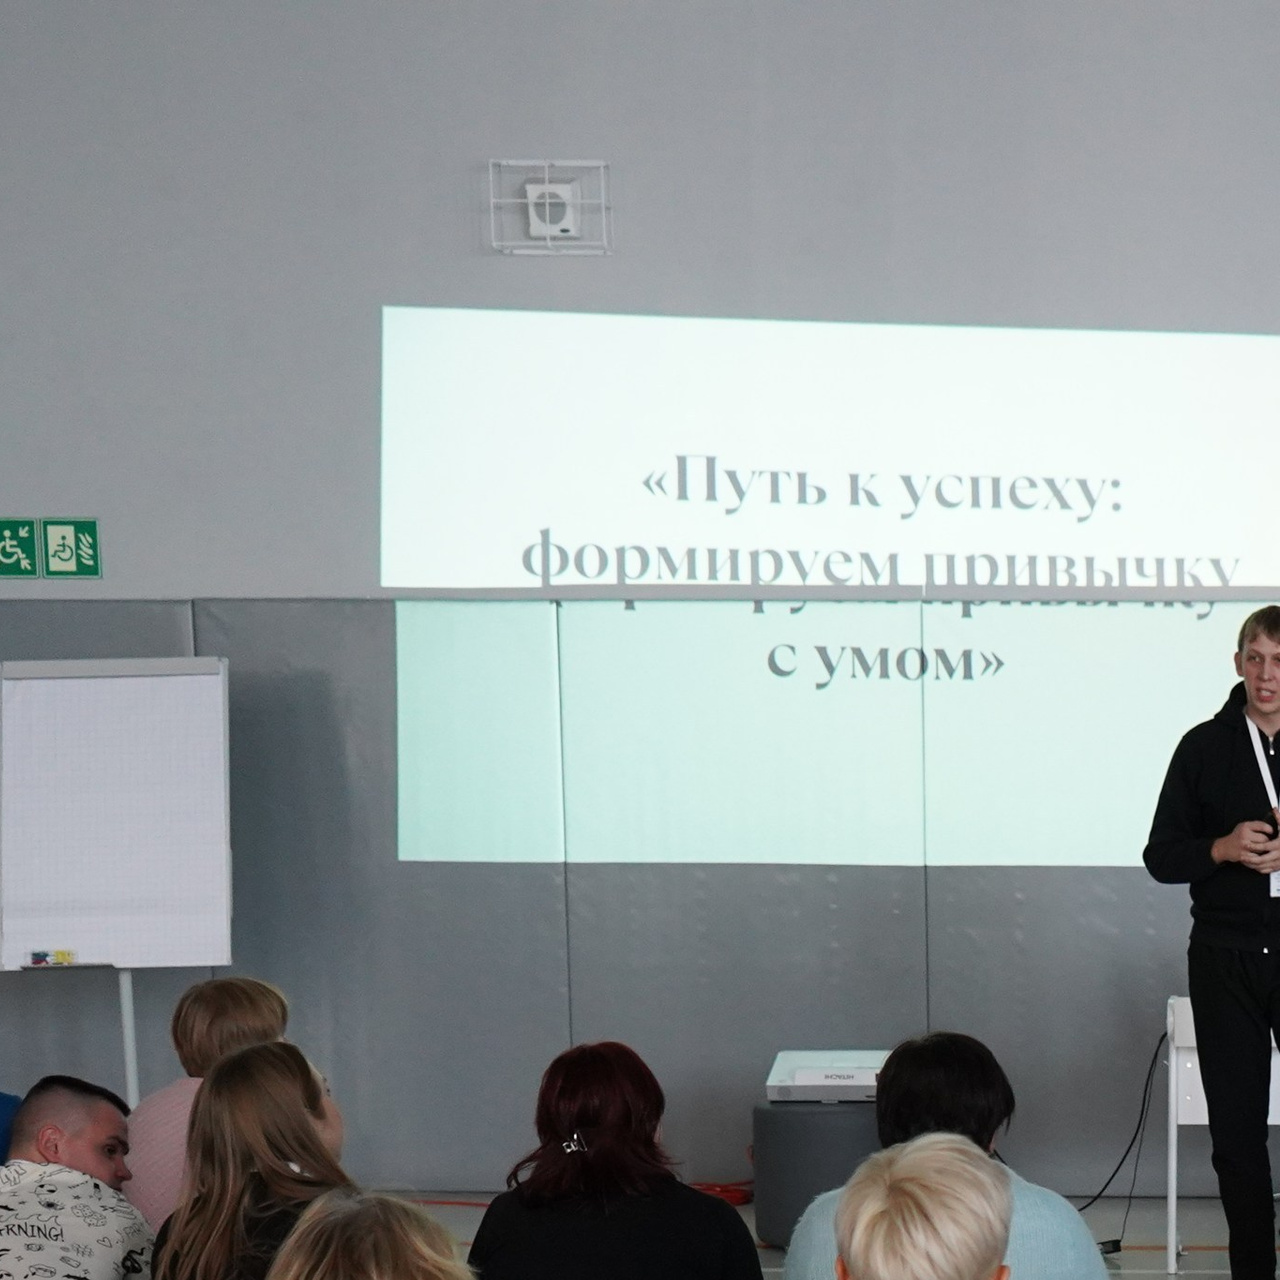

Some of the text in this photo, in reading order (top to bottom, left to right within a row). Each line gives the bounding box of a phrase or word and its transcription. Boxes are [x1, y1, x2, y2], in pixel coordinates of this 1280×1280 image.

[642, 454, 1121, 523] «Путь к успеху:
[521, 527, 1241, 620] формируем привычку
[767, 643, 1006, 690] с умом»
